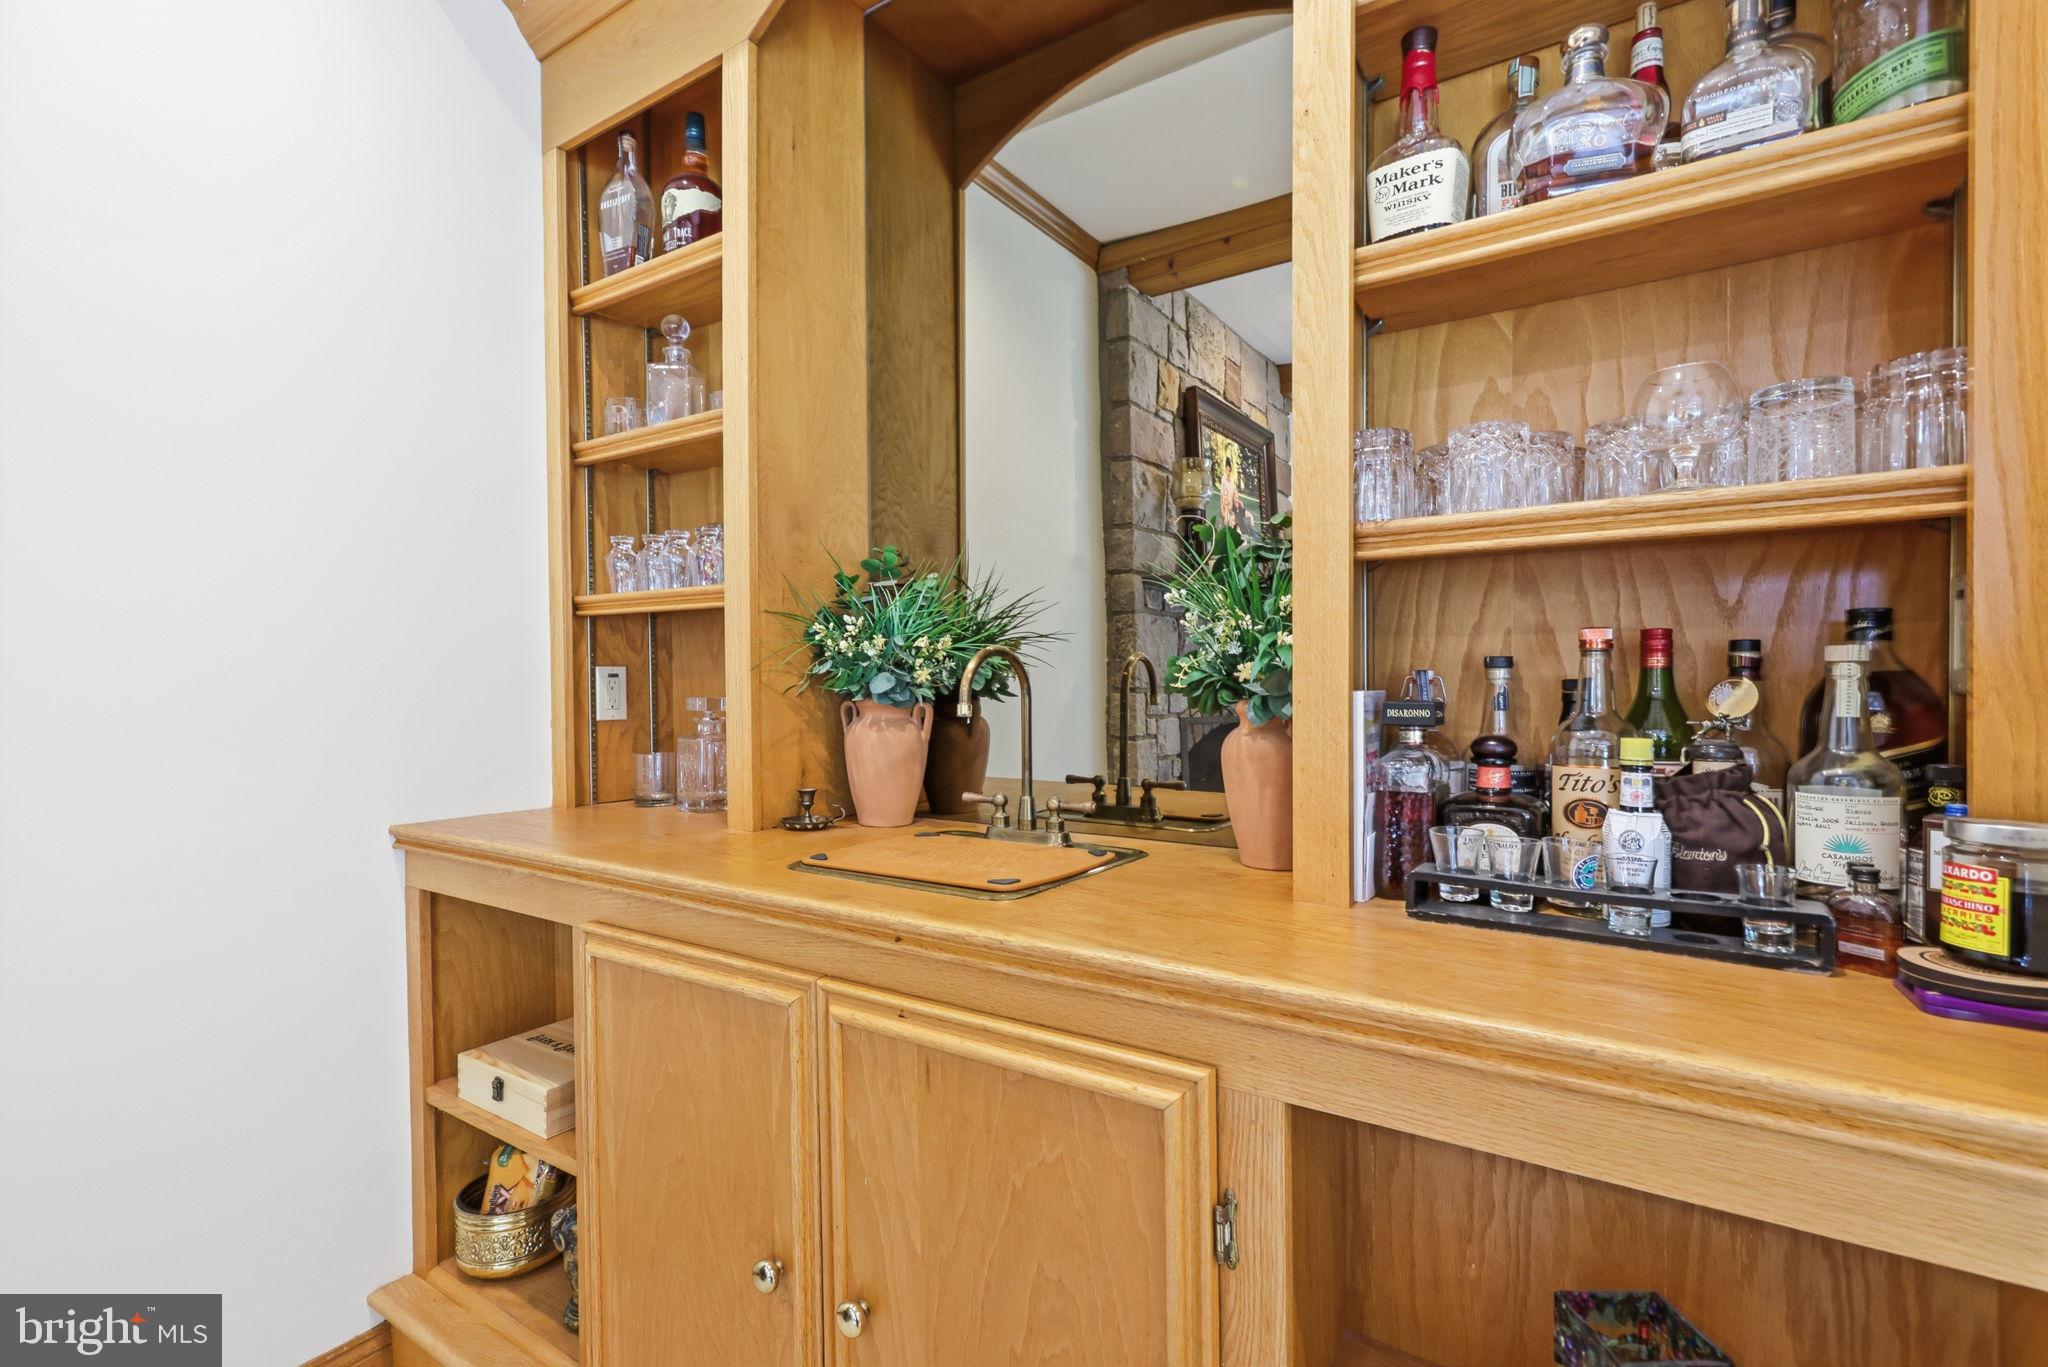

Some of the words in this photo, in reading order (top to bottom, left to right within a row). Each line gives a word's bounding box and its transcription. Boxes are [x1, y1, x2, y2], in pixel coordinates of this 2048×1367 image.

[1891, 58, 1912, 73] RYE
[1694, 81, 1751, 103] WOODFORD
[1375, 159, 1444, 188] Maker's
[1391, 174, 1444, 197] Mark
[1384, 193, 1432, 212] WHISKY
[1386, 708, 1431, 718] DISARONNO
[1558, 771, 1620, 794] Tito's
[1821, 852, 1874, 863] CASAMIGOS
